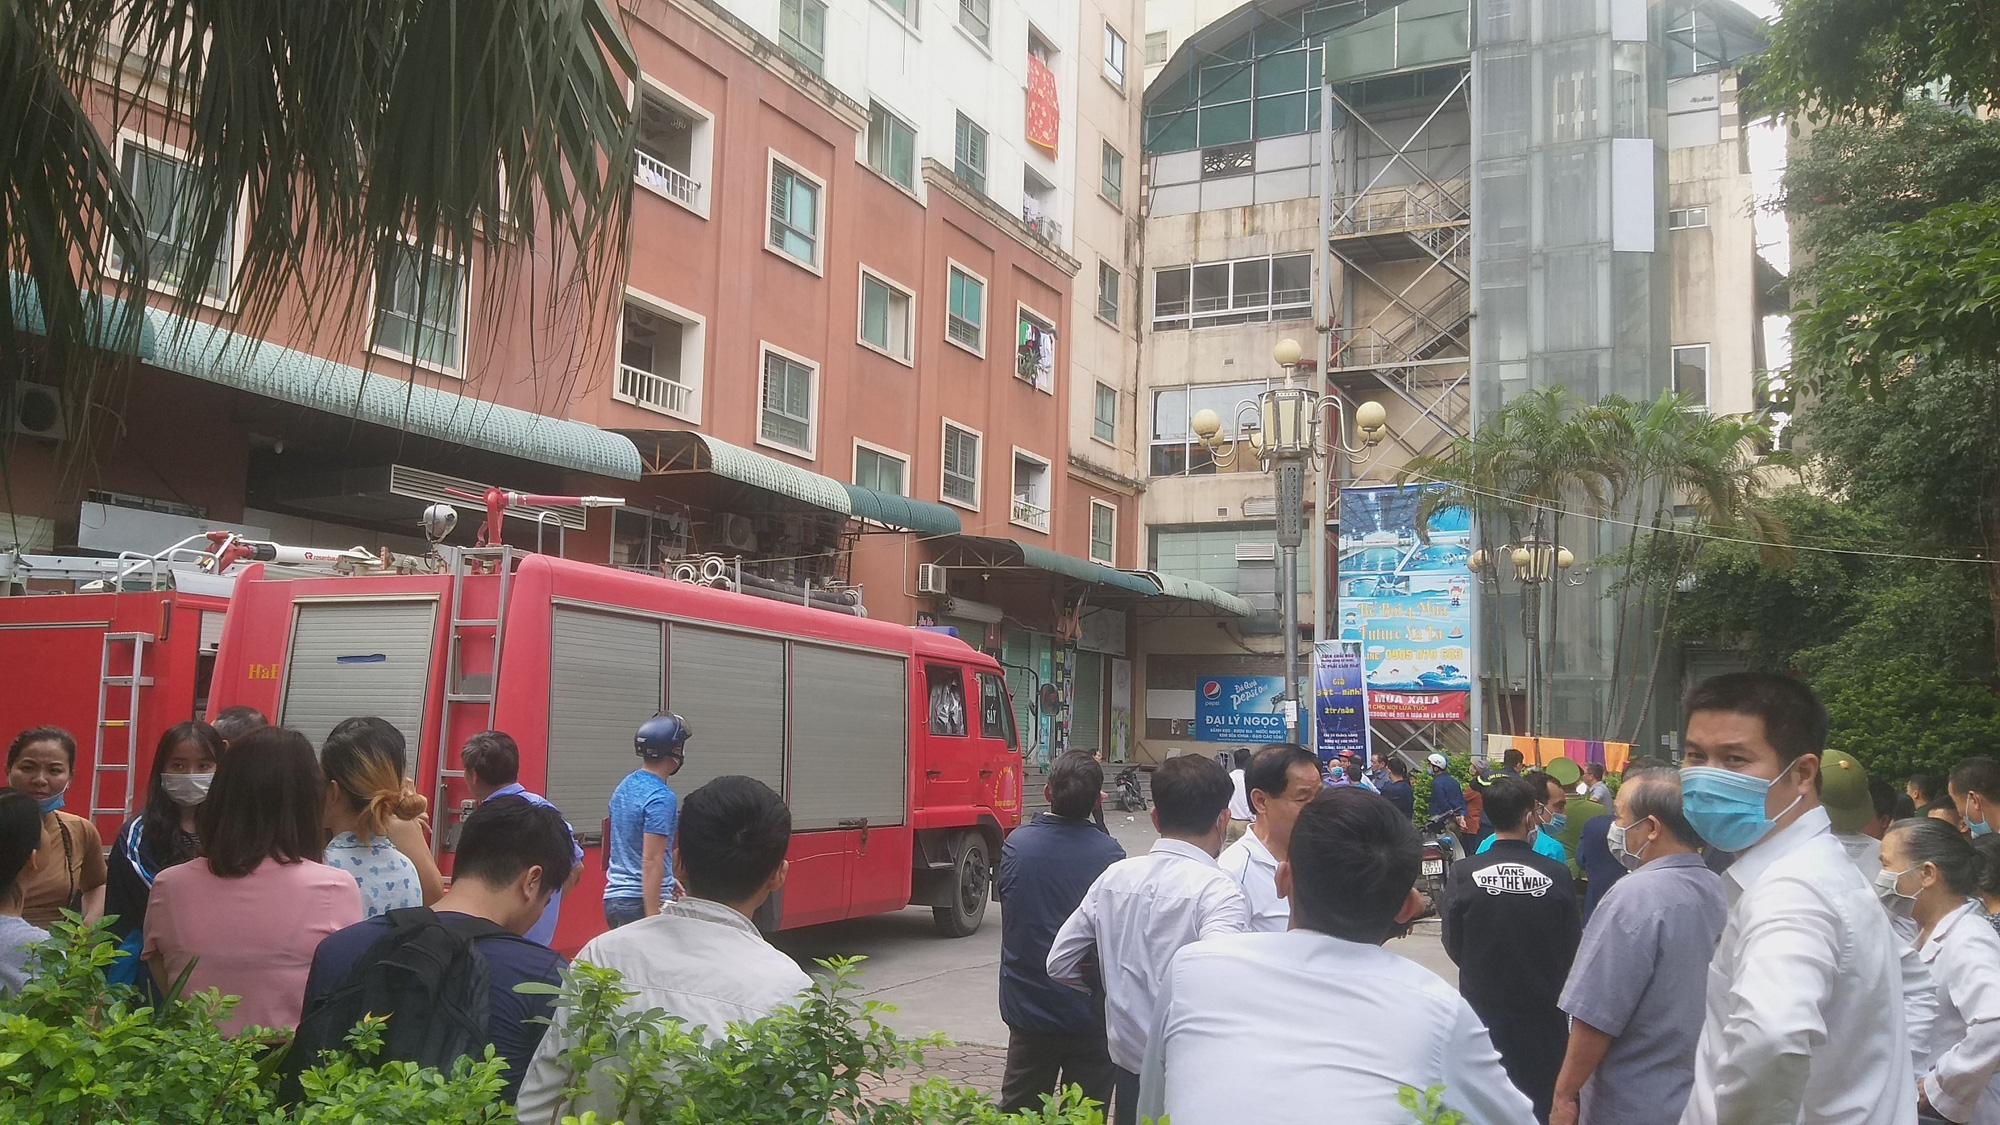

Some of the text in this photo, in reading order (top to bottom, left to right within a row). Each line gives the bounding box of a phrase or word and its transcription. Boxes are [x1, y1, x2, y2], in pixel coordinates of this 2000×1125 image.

[1205, 715, 1225, 727] ĐẠI
[1228, 713, 1240, 725] LÝ
[1243, 716, 1279, 728] NGỌC
[1497, 866, 1525, 876] VANS
[1500, 877, 1520, 889] THE
